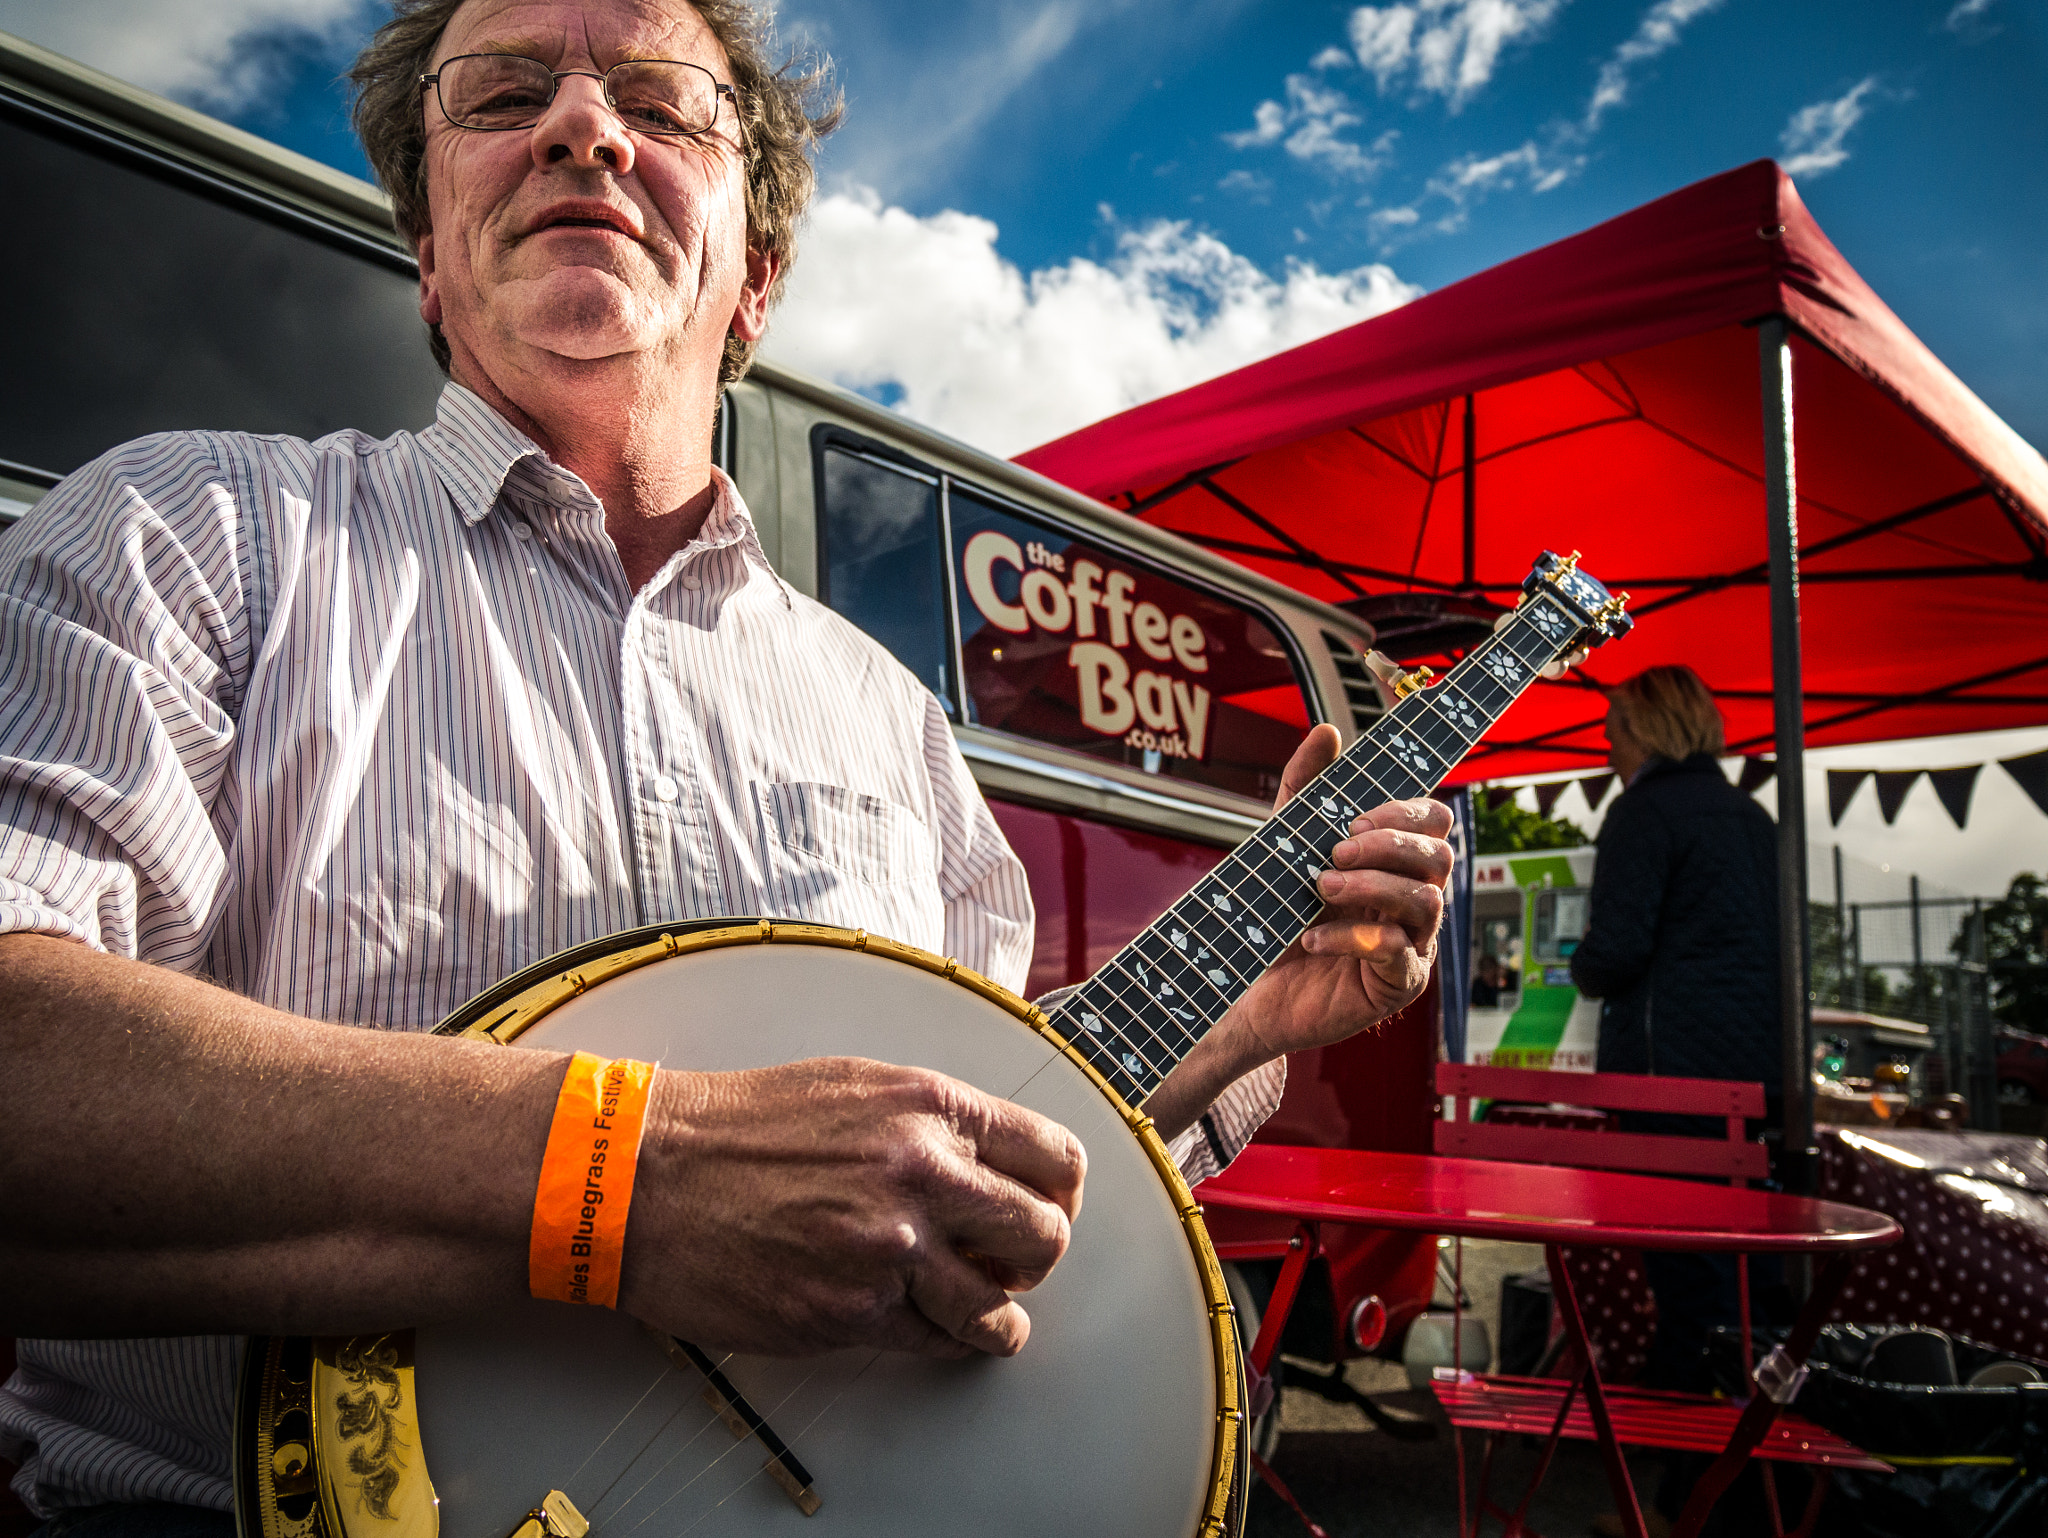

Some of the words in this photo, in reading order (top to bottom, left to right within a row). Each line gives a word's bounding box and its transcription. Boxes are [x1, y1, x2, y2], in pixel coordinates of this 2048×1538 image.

[963, 530, 1209, 673] Coffee
[1026, 541, 1065, 573] the
[1068, 641, 1210, 761] Bay
[1124, 728, 1189, 760] .co.uk
[570, 1138, 609, 1257] Bluegrass
